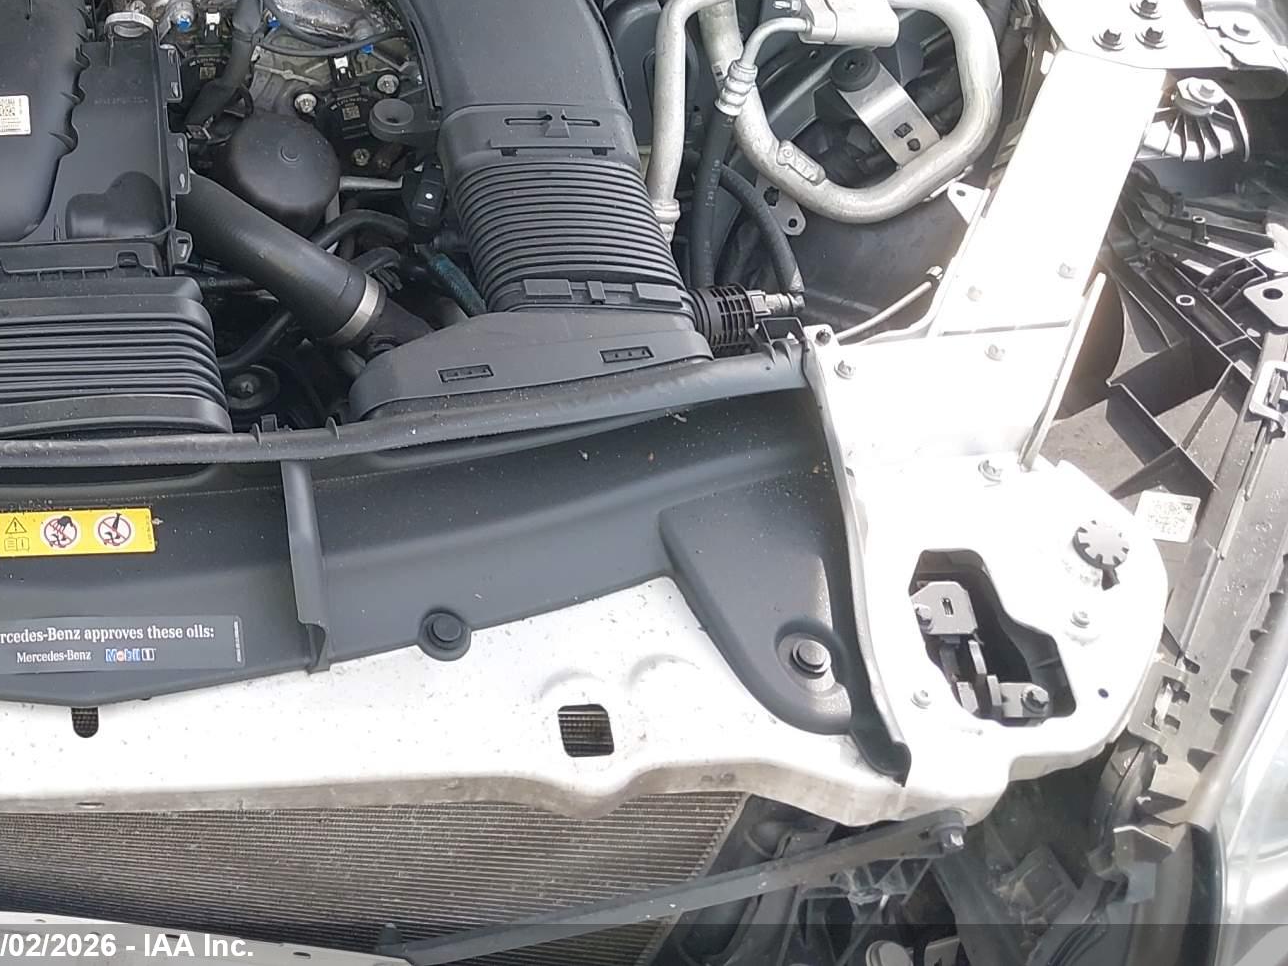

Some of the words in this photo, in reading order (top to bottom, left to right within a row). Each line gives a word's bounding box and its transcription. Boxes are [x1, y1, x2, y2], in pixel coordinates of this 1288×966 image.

[84, 627, 144, 642] approves
[147, 625, 183, 639] these
[186, 624, 215, 638] oils:
[16, 649, 92, 663] Mercedes-Benz
[105, 648, 141, 662] Mobil
